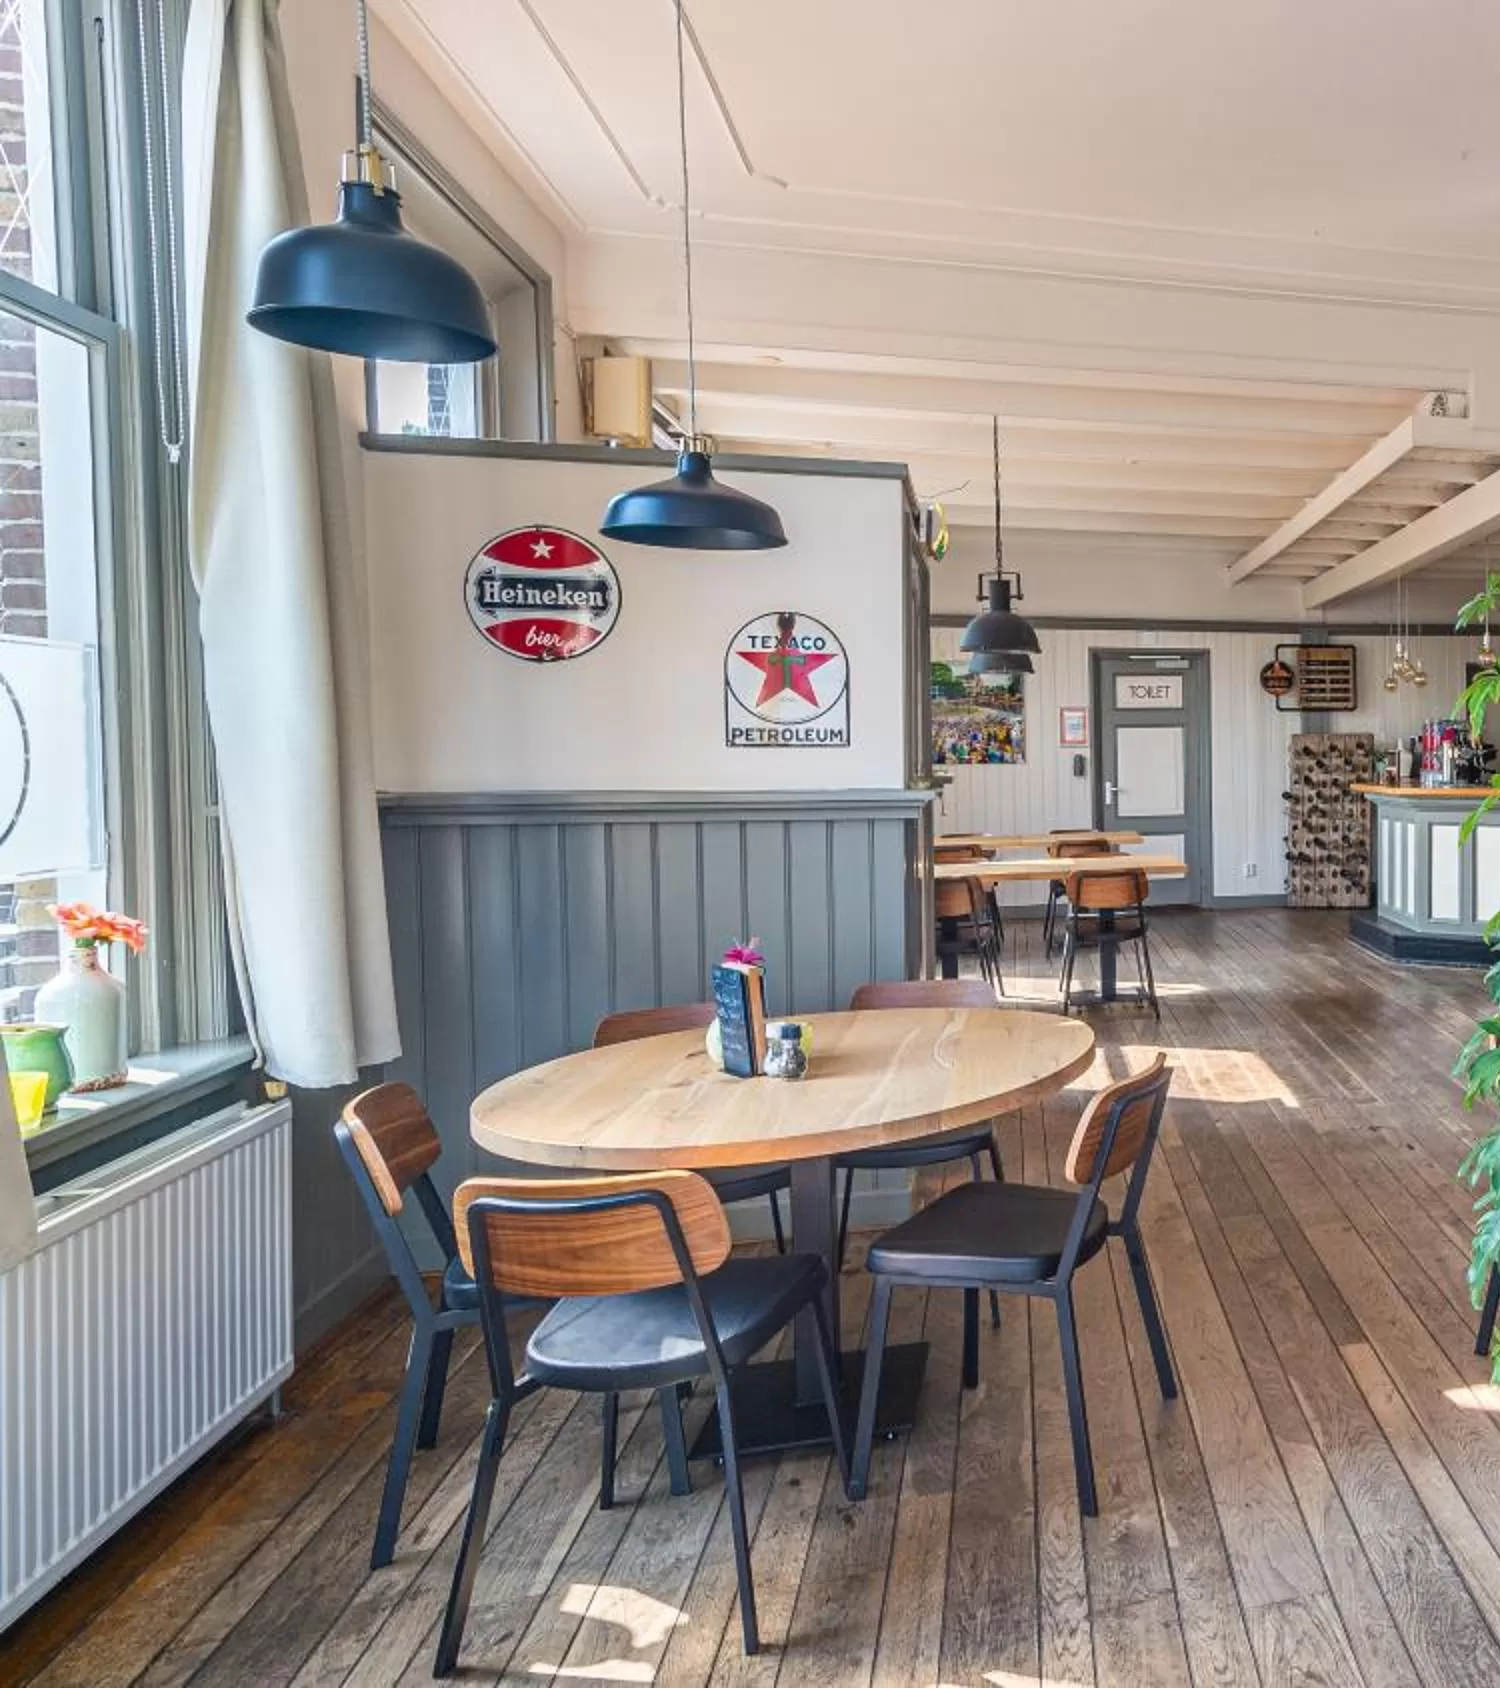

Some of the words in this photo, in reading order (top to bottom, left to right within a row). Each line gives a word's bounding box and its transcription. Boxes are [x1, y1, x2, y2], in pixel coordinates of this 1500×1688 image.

[482, 580, 605, 606] Heineken
[525, 625, 563, 647] bier
[747, 635, 826, 651] TEXACO
[1128, 685, 1171, 699] TOILET
[731, 728, 843, 743] PETROLEUM
